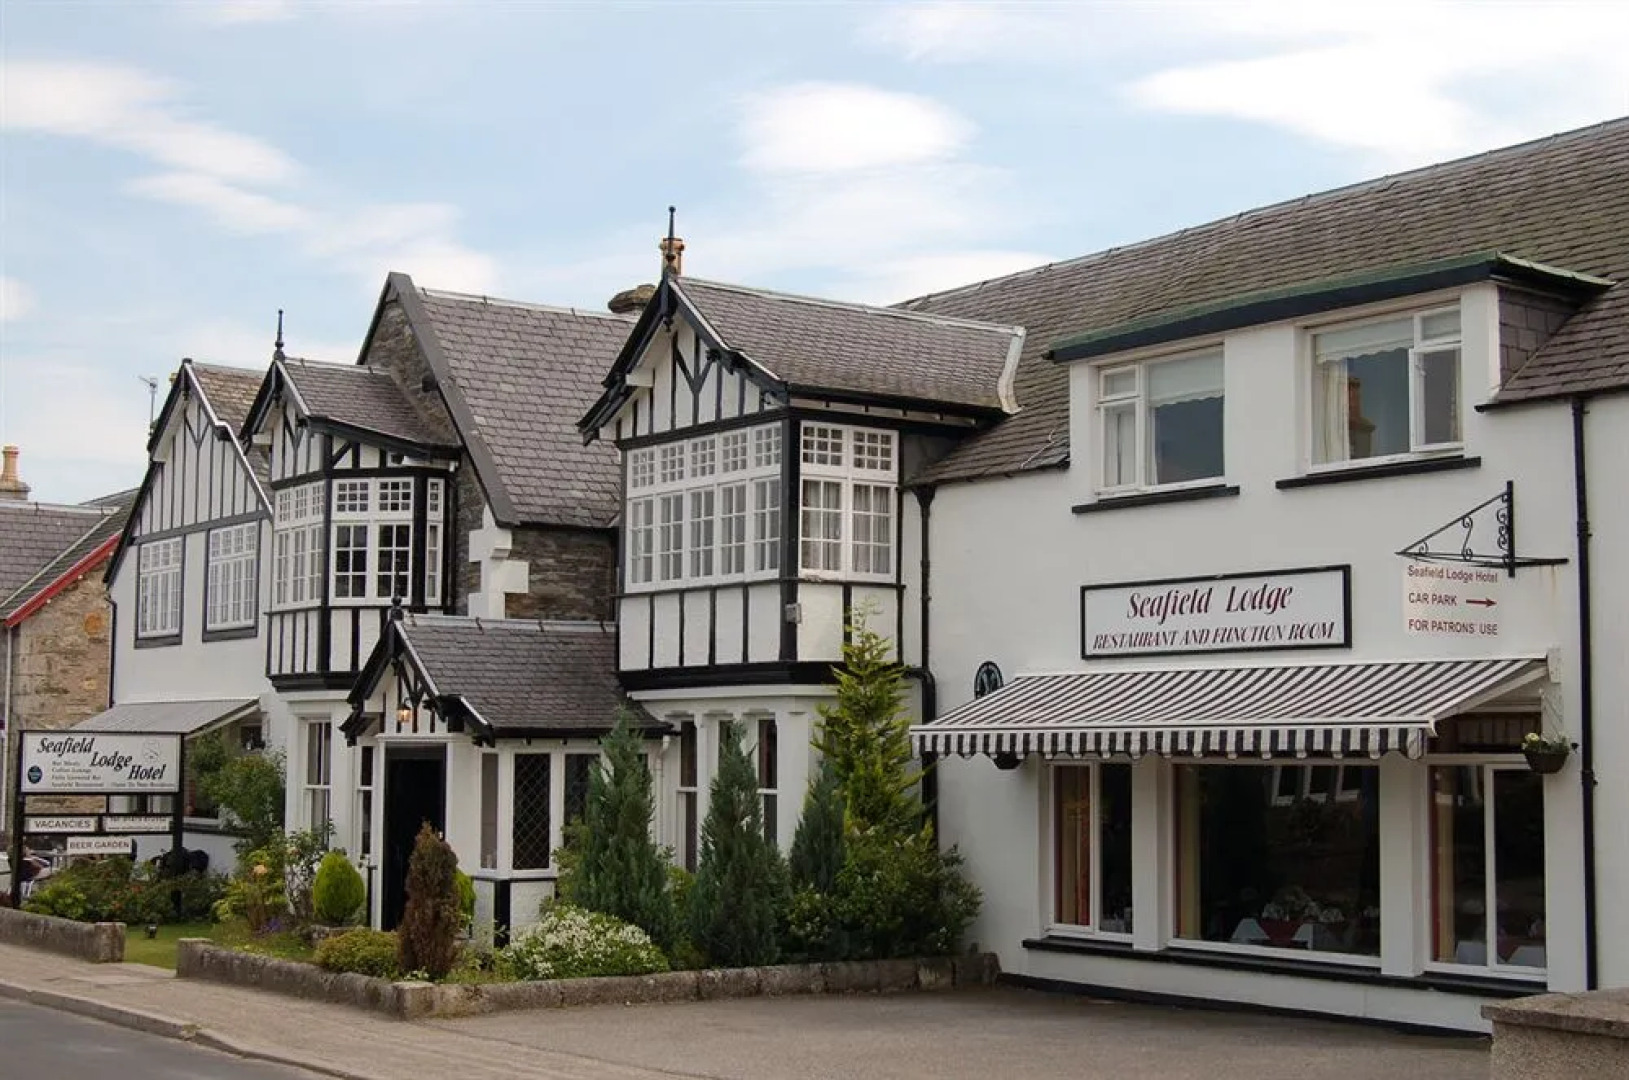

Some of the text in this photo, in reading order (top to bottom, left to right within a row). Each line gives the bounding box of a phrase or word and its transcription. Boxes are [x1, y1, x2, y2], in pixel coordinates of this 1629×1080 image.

[1407, 564, 1498, 583] Seafield Lodge Hotel
[1127, 583, 1293, 625] Seafield Lodge
[1408, 592, 1457, 606] CAR PARK
[1093, 621, 1335, 649] RESTAURANT AND FUNCTION ROOM
[1408, 618, 1429, 631] FOR
[1479, 623, 1498, 636] USE
[37, 736, 167, 780] Seafield Lodge Hotel
[34, 820, 91, 829] VACANCIES
[69, 840, 130, 849] BEER GARDEN
